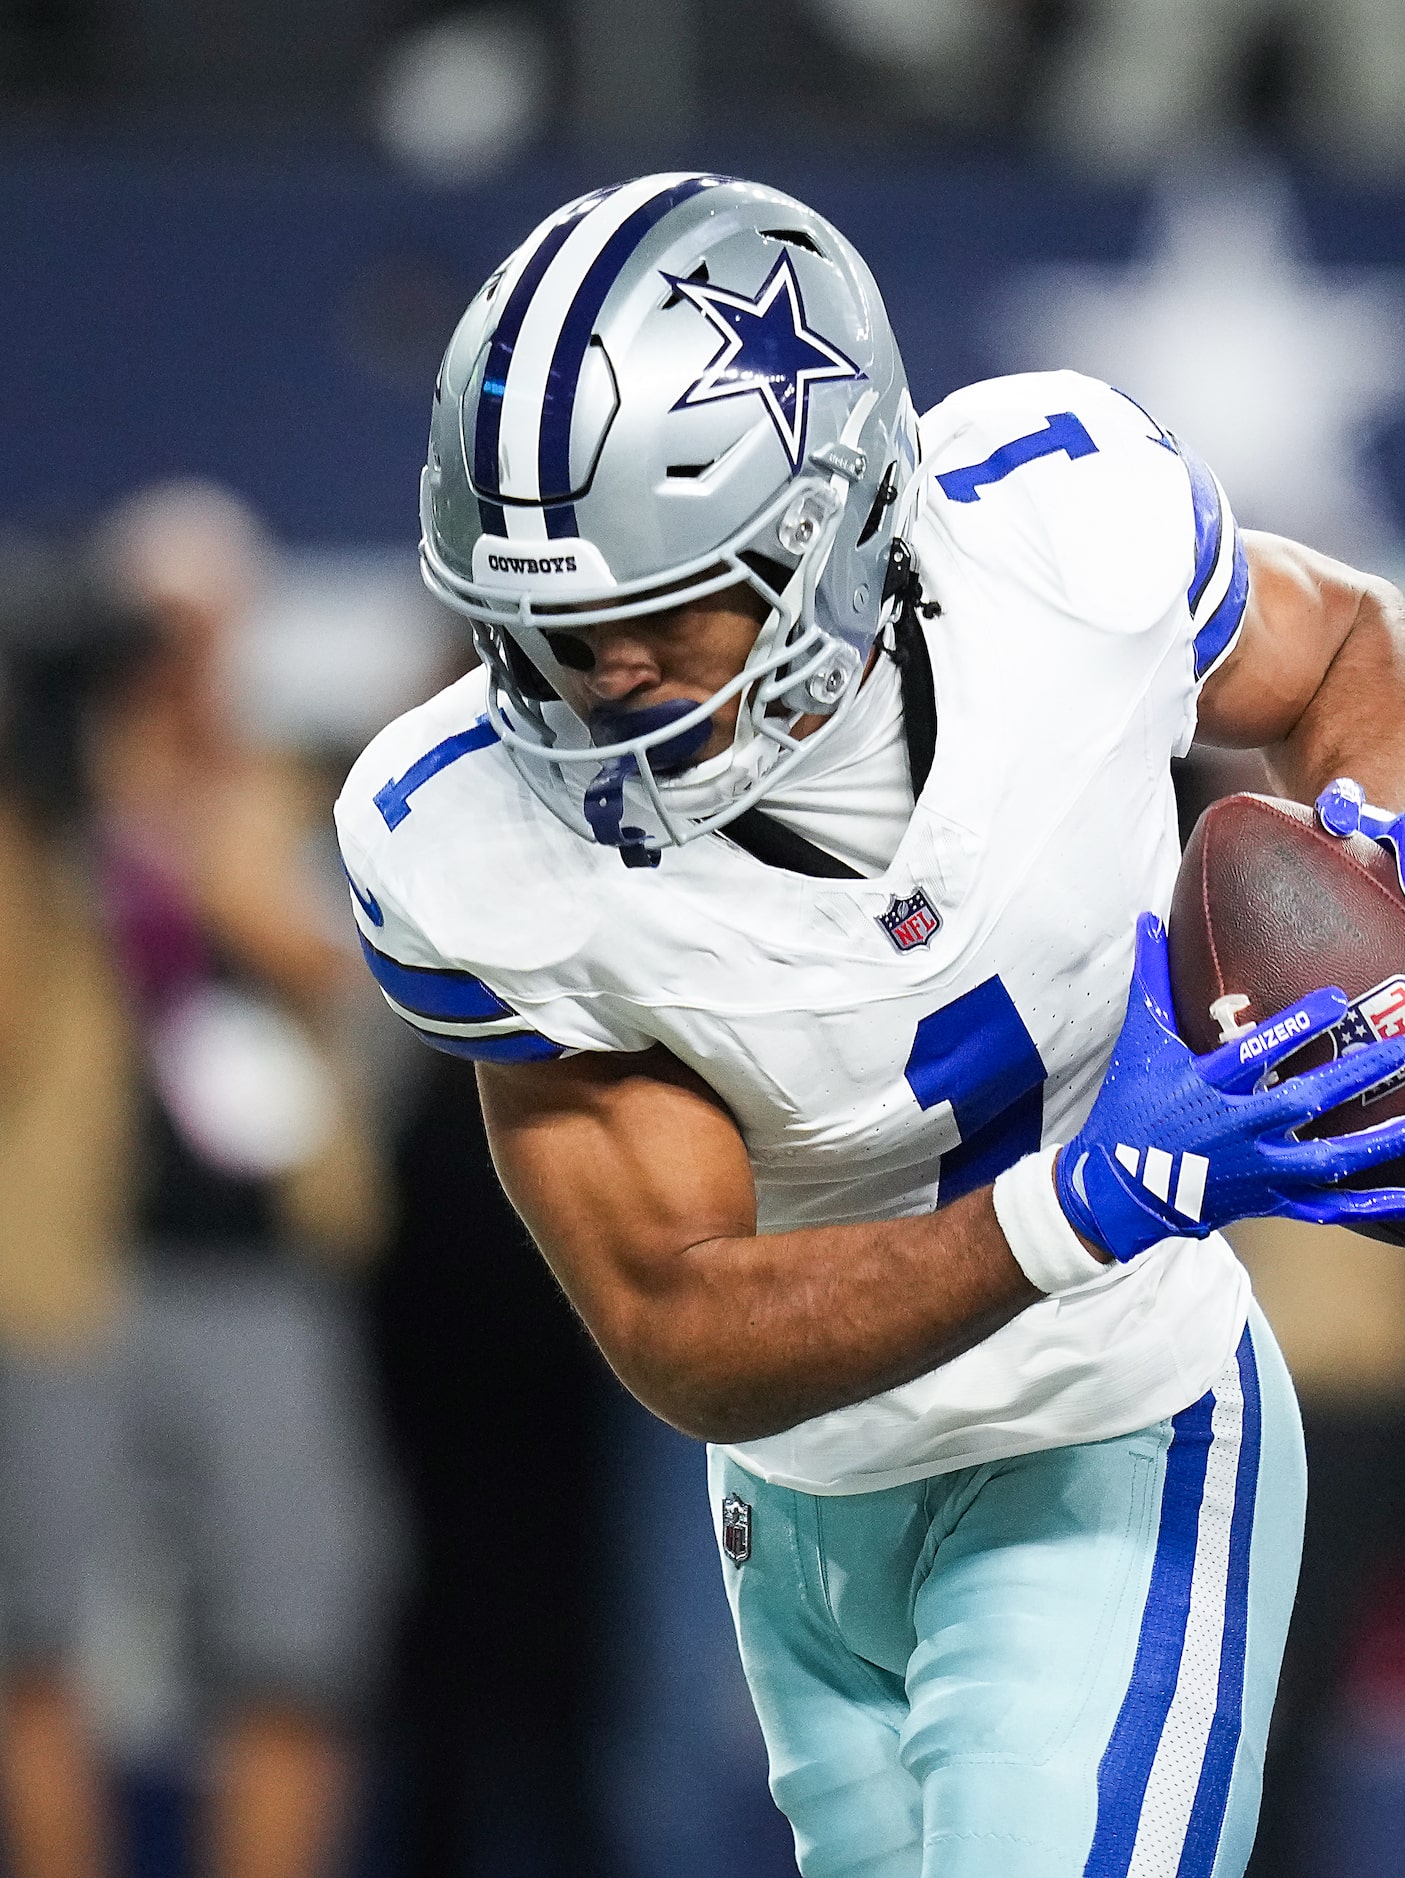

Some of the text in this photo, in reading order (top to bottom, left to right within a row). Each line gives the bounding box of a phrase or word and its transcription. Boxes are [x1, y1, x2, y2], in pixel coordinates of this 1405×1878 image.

[934, 411, 1100, 503] 1
[488, 554, 577, 574] COWBOYS
[373, 708, 516, 832] 1
[894, 910, 936, 946] NFL
[1240, 1010, 1311, 1064] ADIZERO
[904, 973, 1048, 1210] 1
